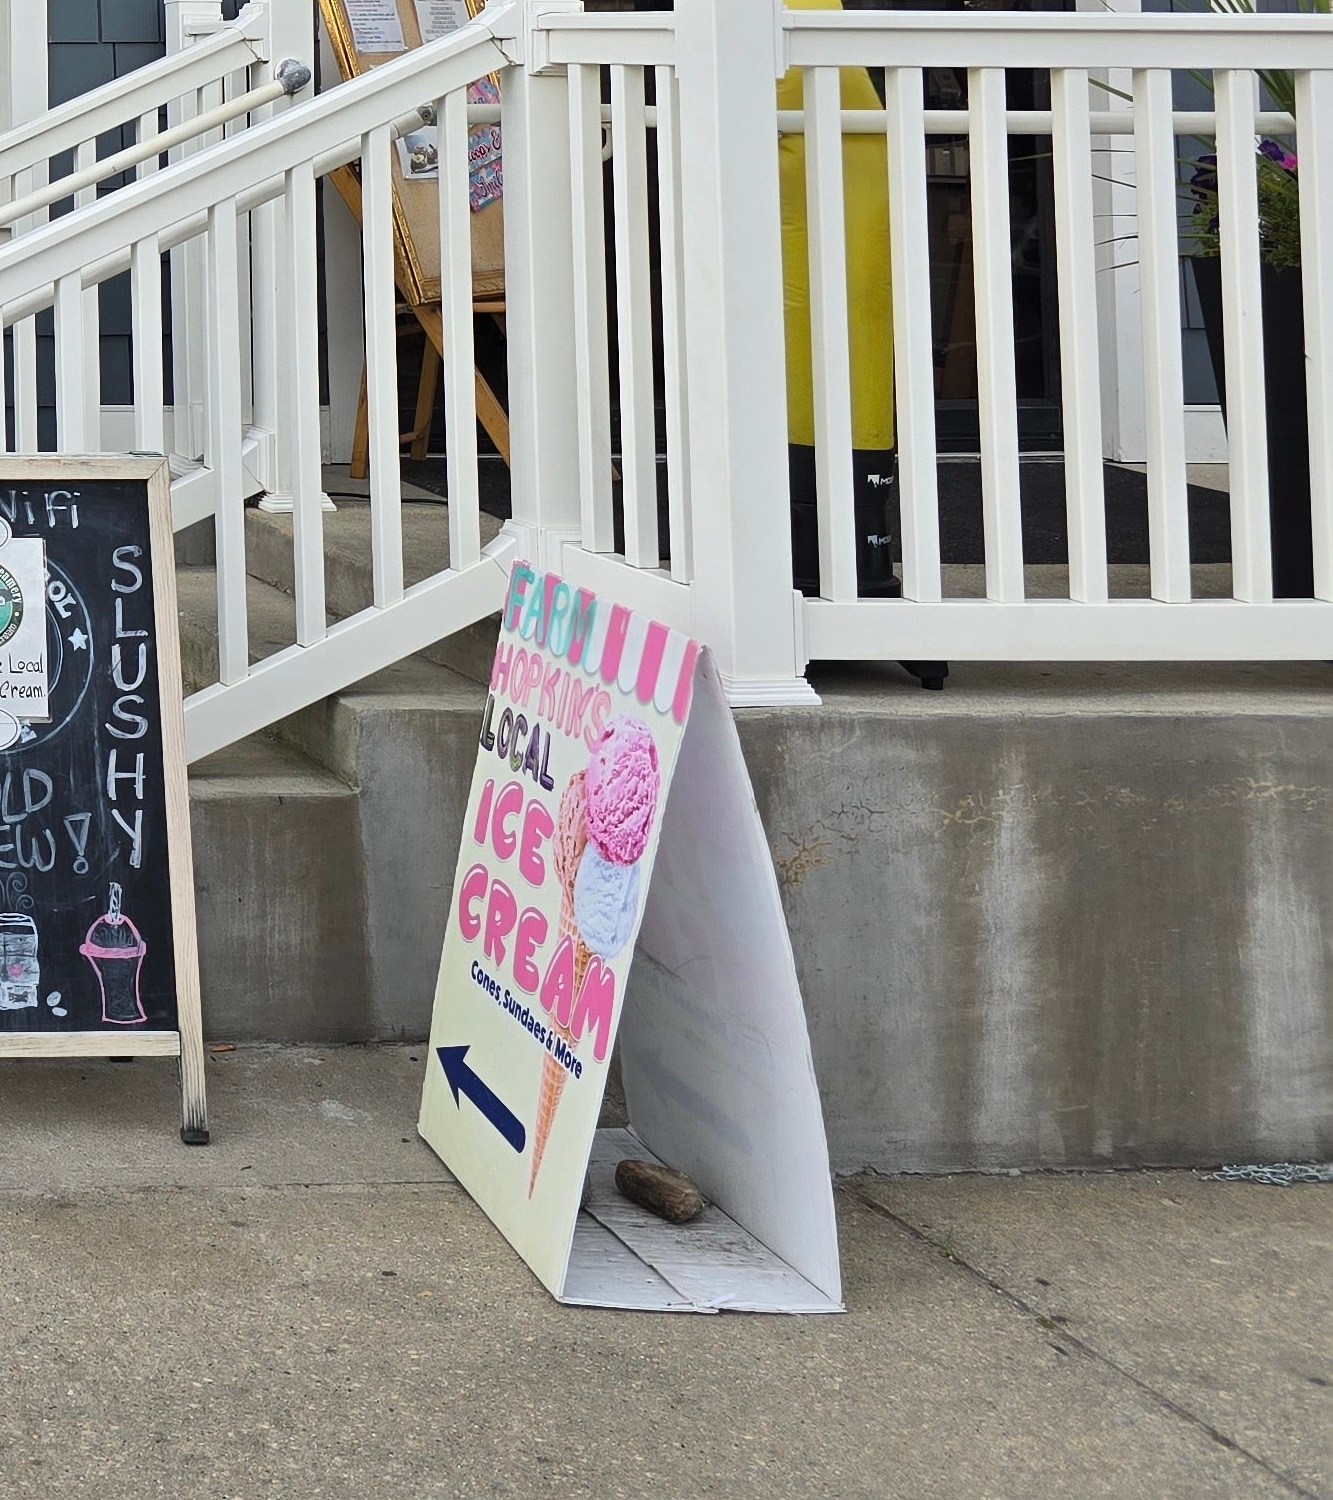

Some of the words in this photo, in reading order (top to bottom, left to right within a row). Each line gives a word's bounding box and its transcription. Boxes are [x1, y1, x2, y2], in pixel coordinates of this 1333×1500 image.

[8, 652, 44, 674] Local
[504, 565, 598, 665] FARM
[106, 545, 149, 870] SLUSHY
[480, 693, 555, 792] LOCAL
[473, 778, 555, 887] ICE
[458, 862, 617, 1064] CREAM
[502, 989, 547, 1044] Sundaes
[545, 1033, 555, 1051] &
[554, 1037, 583, 1080] More
